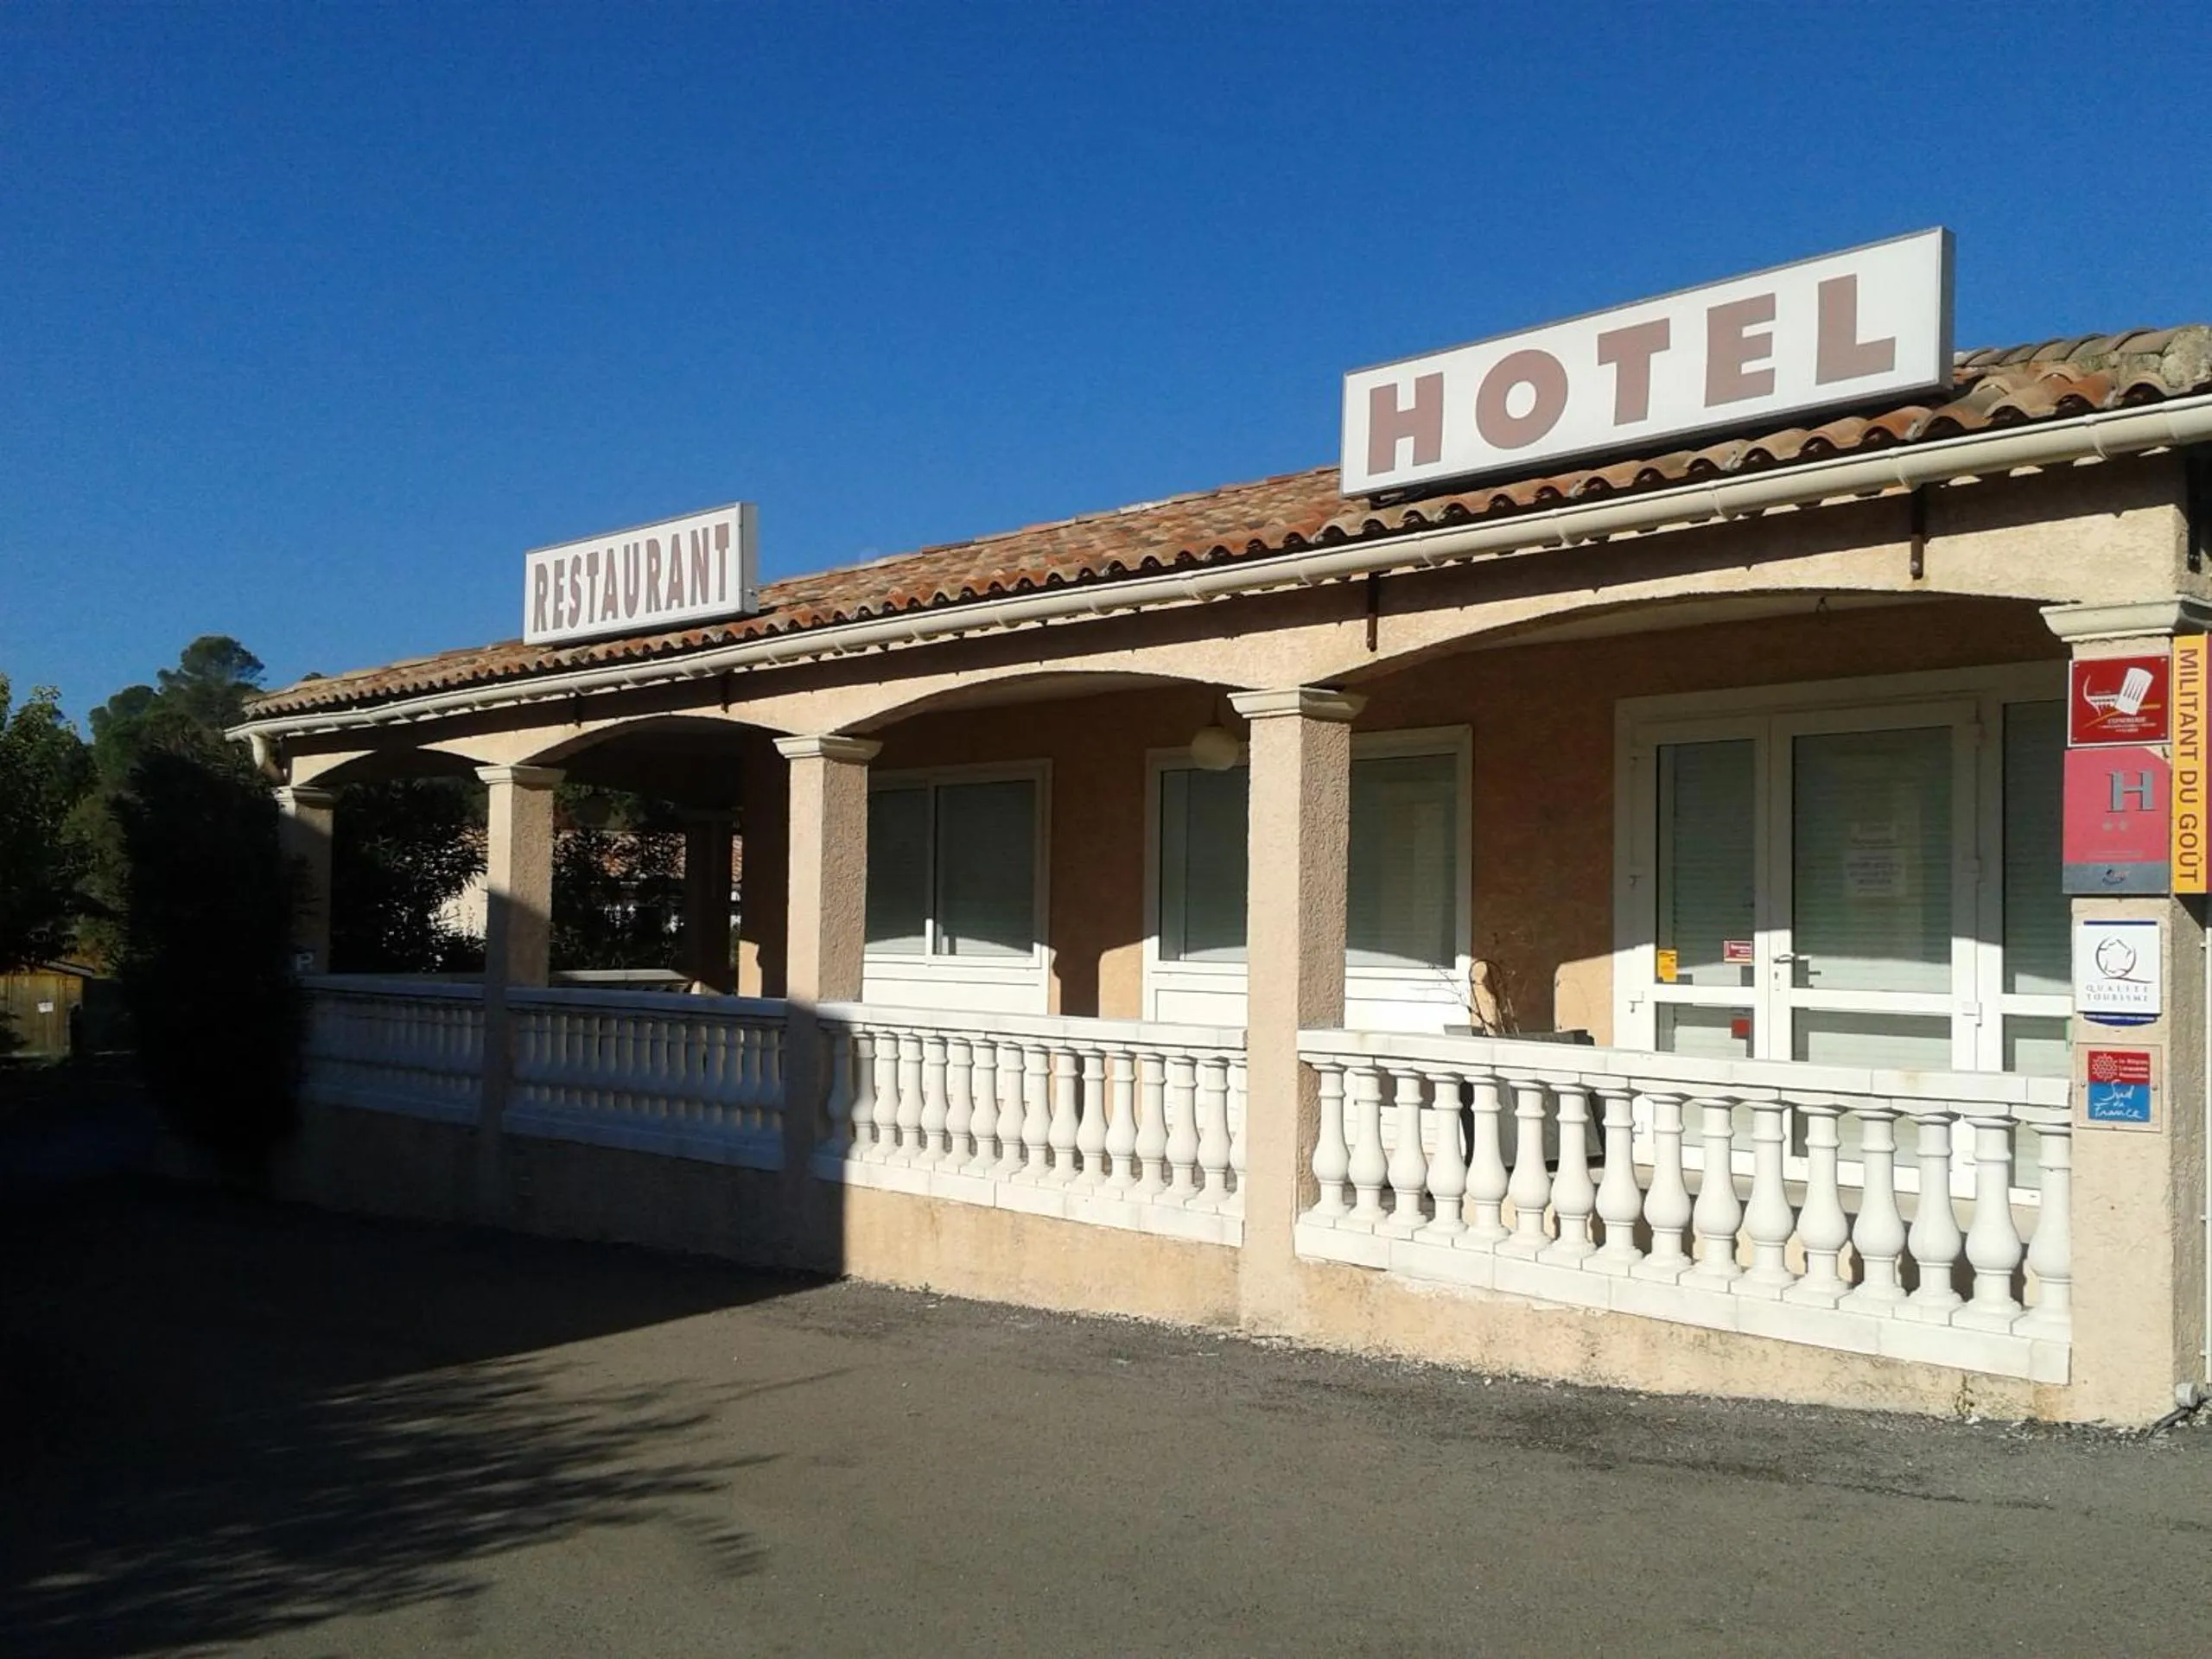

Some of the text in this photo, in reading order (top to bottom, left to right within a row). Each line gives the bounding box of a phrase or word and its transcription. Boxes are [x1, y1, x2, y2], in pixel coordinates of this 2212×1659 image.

[1367, 273, 1897, 476] HOTEL
[532, 522, 730, 633] RESTAURANT
[2178, 648, 2202, 883] MILITANT DU GOÛT
[2106, 769, 2157, 813] H
[2087, 993, 2148, 1002] TOURISME
[2093, 1102, 2144, 1120] France
[2100, 1079, 2135, 1102] Sud
